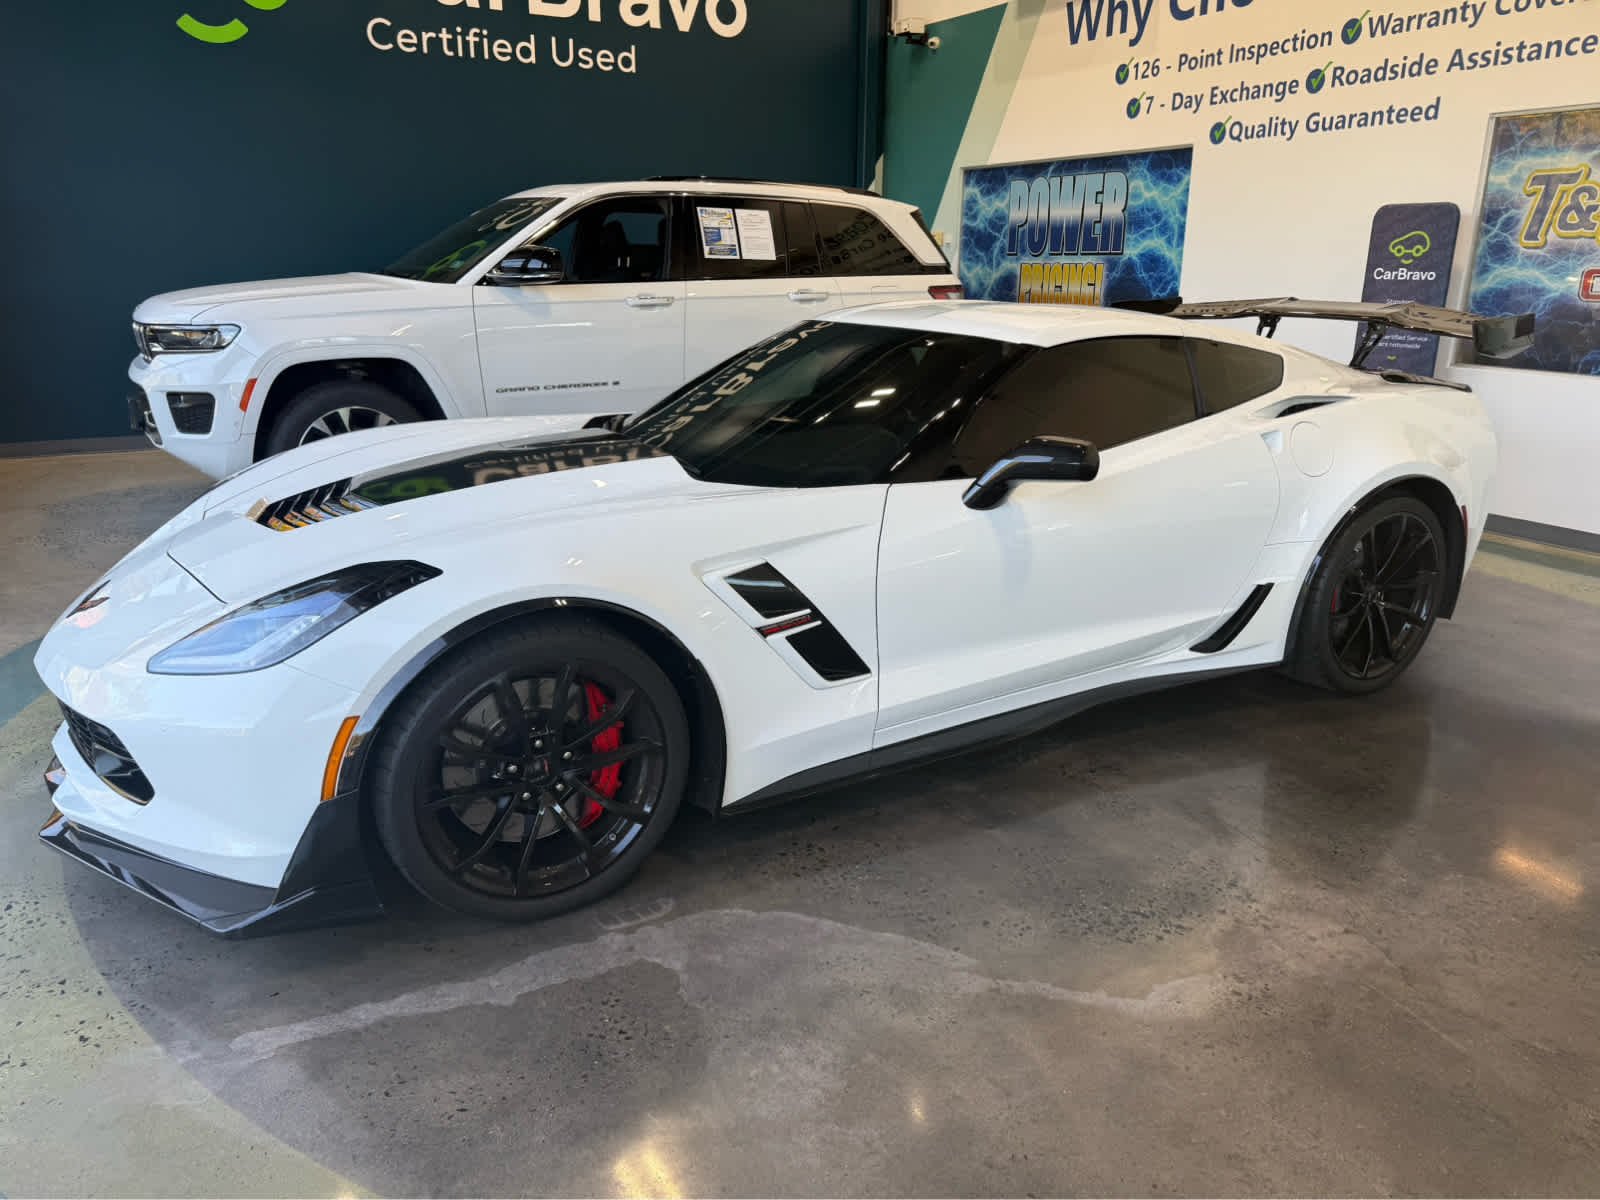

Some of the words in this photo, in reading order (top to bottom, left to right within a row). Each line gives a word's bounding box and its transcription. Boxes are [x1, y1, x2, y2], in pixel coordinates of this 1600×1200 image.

[366, 17, 536, 64] Certified
[551, 36, 637, 73] Used
[1066, 0, 1153, 47] Why
[1133, 58, 1160, 80] 126
[1178, 50, 1223, 72] Point
[1229, 29, 1333, 65] Inspection
[1368, 1, 1486, 38] Warranty
[1145, 96, 1154, 114] 7
[1171, 92, 1203, 113] Day
[1209, 79, 1299, 105] Exchange
[1331, 52, 1439, 88] Roadside
[1446, 33, 1599, 72] Assistance
[1228, 115, 1299, 142] Quality
[1305, 96, 1440, 134] Guaranteed
[1006, 171, 1128, 257] POWER
[1373, 267, 1437, 281] CarBravo
